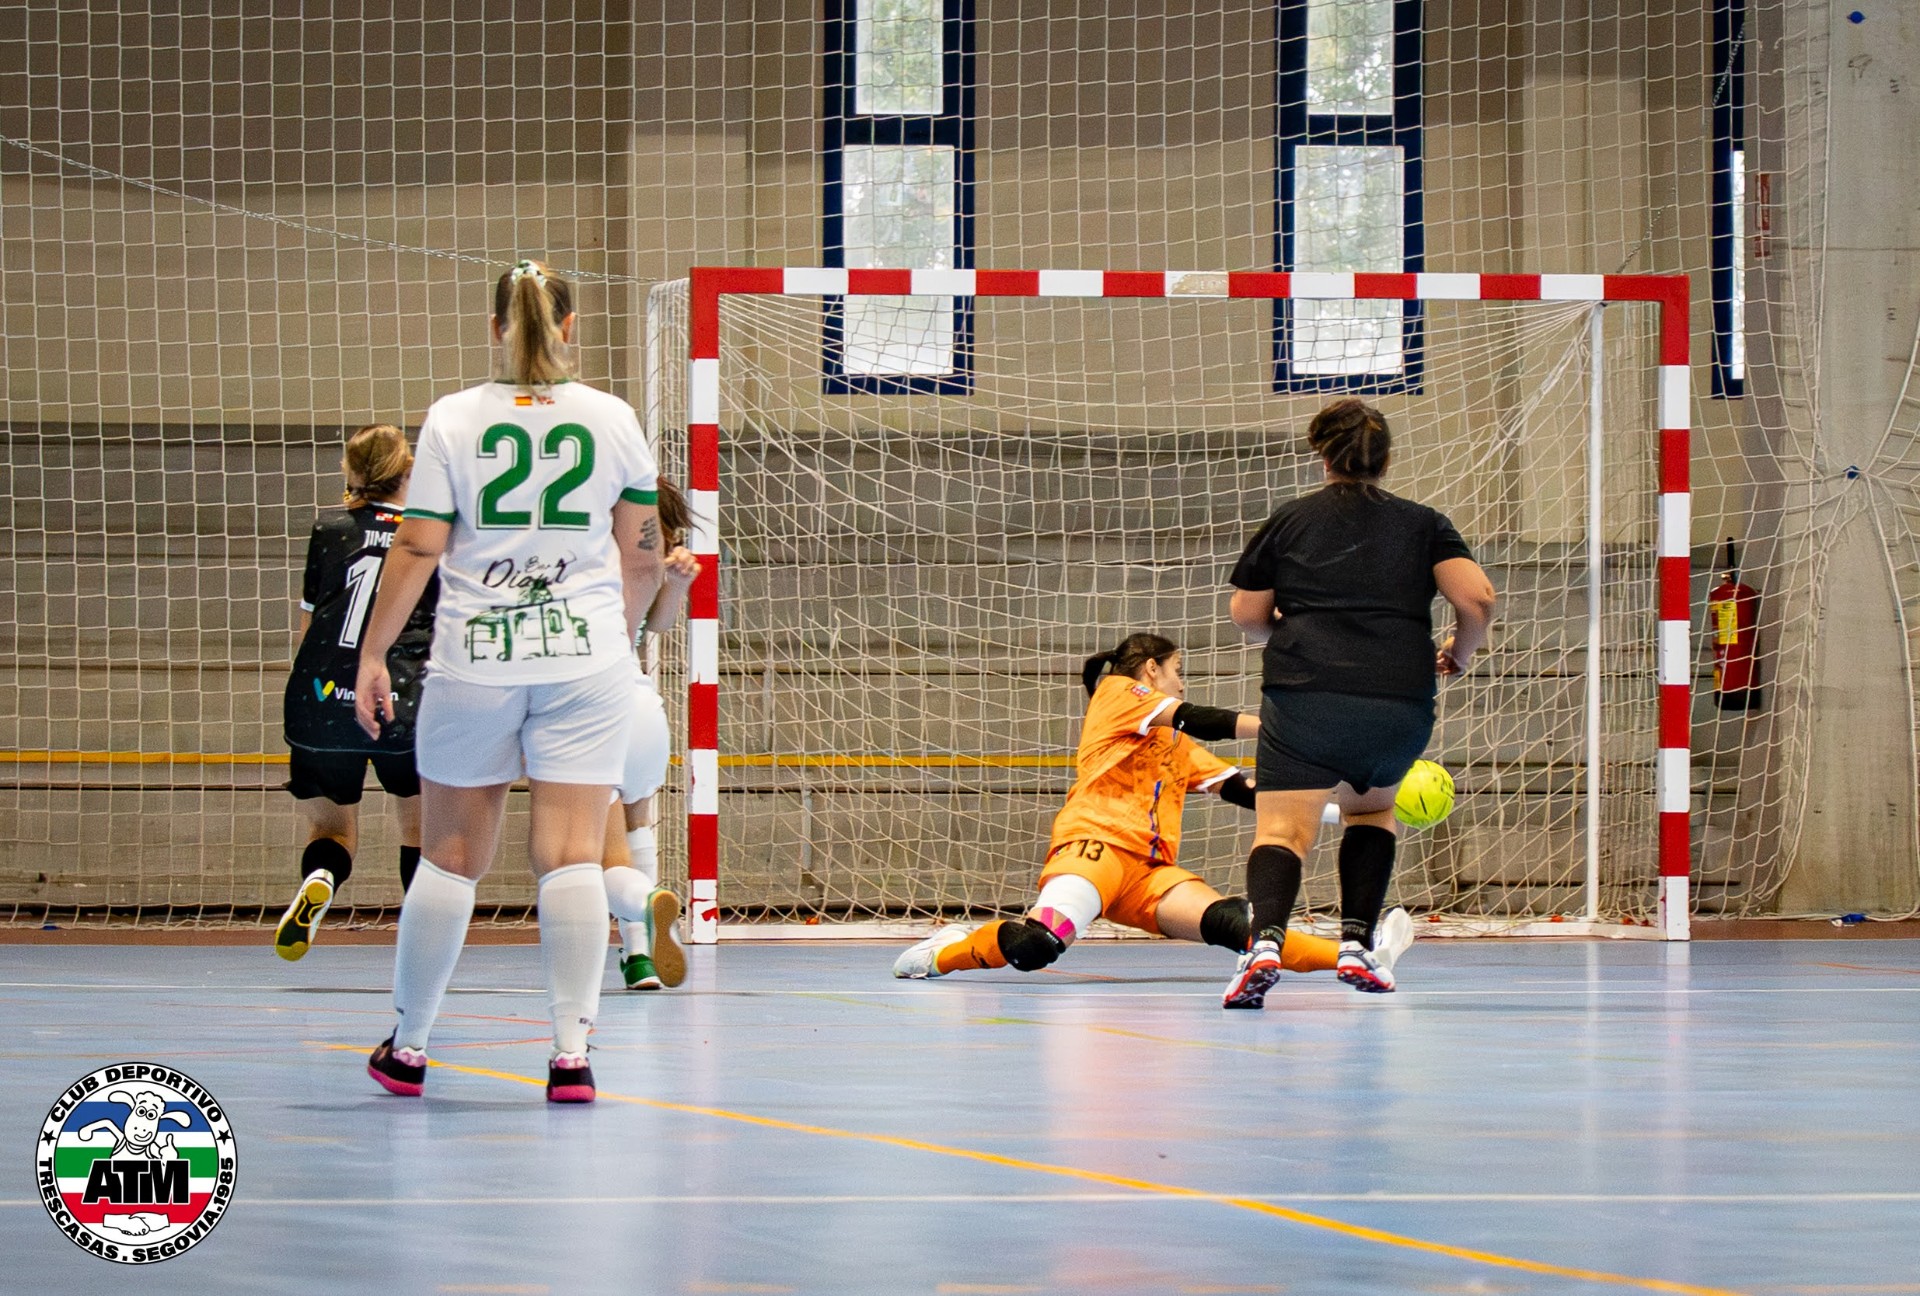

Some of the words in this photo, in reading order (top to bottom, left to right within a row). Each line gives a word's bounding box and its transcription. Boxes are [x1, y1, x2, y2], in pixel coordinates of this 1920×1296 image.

[477, 422, 595, 530] 22
[362, 529, 396, 549] JIME
[339, 555, 384, 649] 1
[1077, 839, 1105, 862] 13
